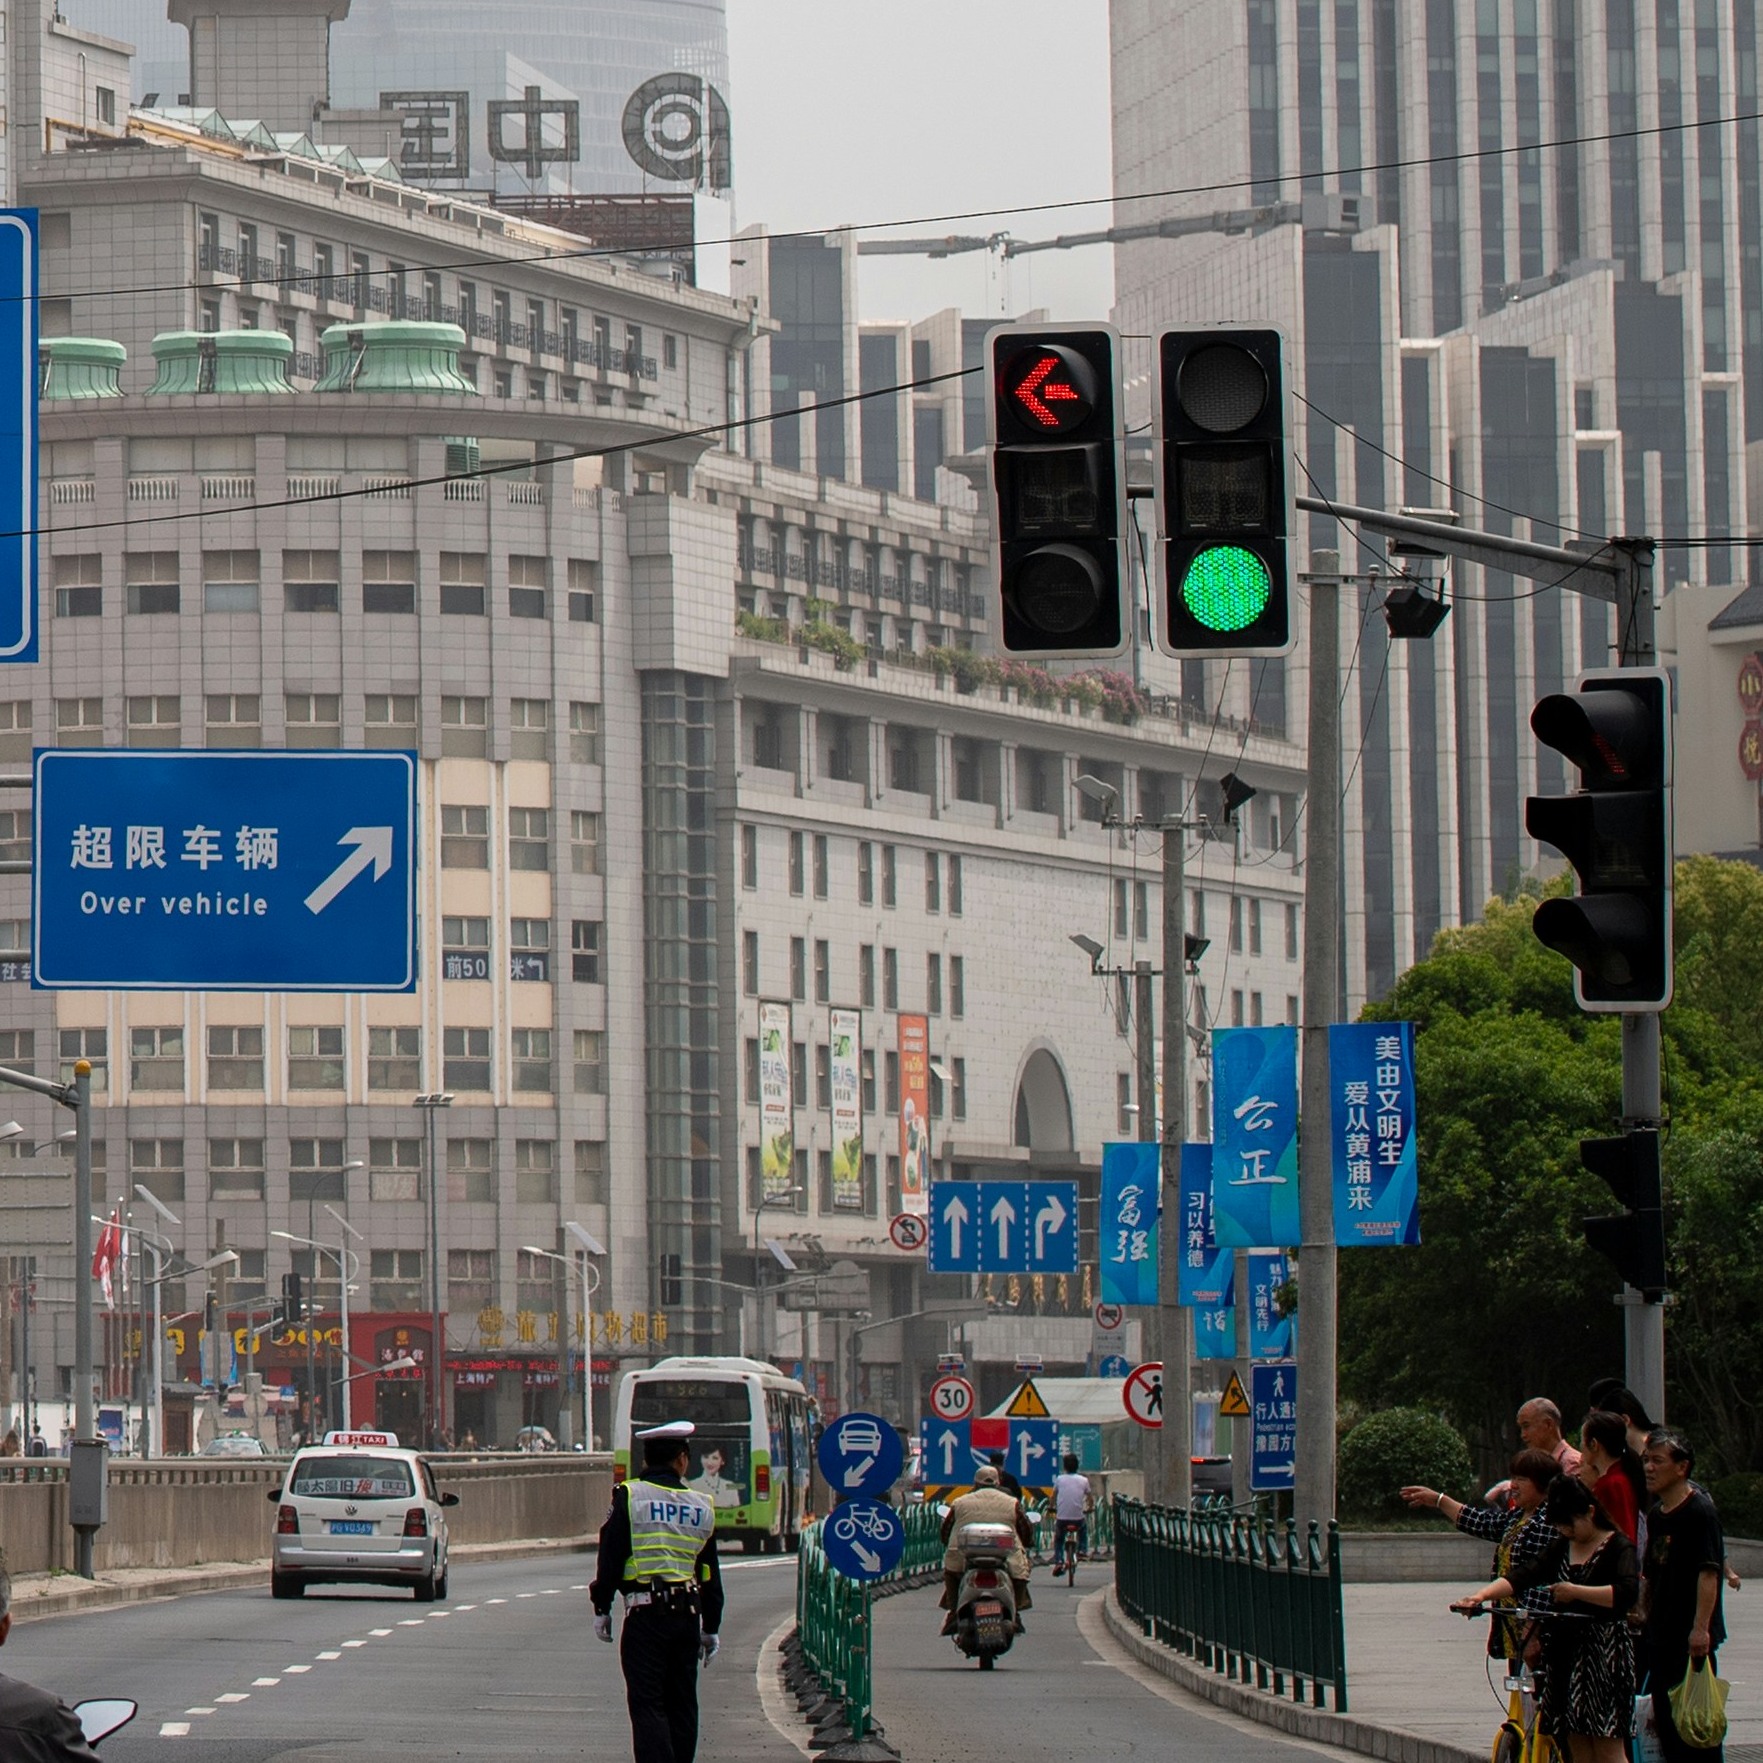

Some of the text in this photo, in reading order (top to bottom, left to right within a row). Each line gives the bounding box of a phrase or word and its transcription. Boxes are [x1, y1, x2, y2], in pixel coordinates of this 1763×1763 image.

[70, 824, 279, 871] 超限车辆
[80, 891, 268, 916] Over vehicle
[1375, 1036, 1403, 1165] 美由文明生
[1228, 1095, 1287, 1185] 公正
[1344, 1081, 1373, 1211] 爱从黄浦来
[1110, 1185, 1149, 1263] 富强
[1187, 1192, 1205, 1268] 习以养德
[456, 1373, 494, 1385] 上海特产
[940, 1389, 965, 1409] 30
[363, 1435, 384, 1445] TAXI
[650, 1501, 702, 1526] HPFJ
